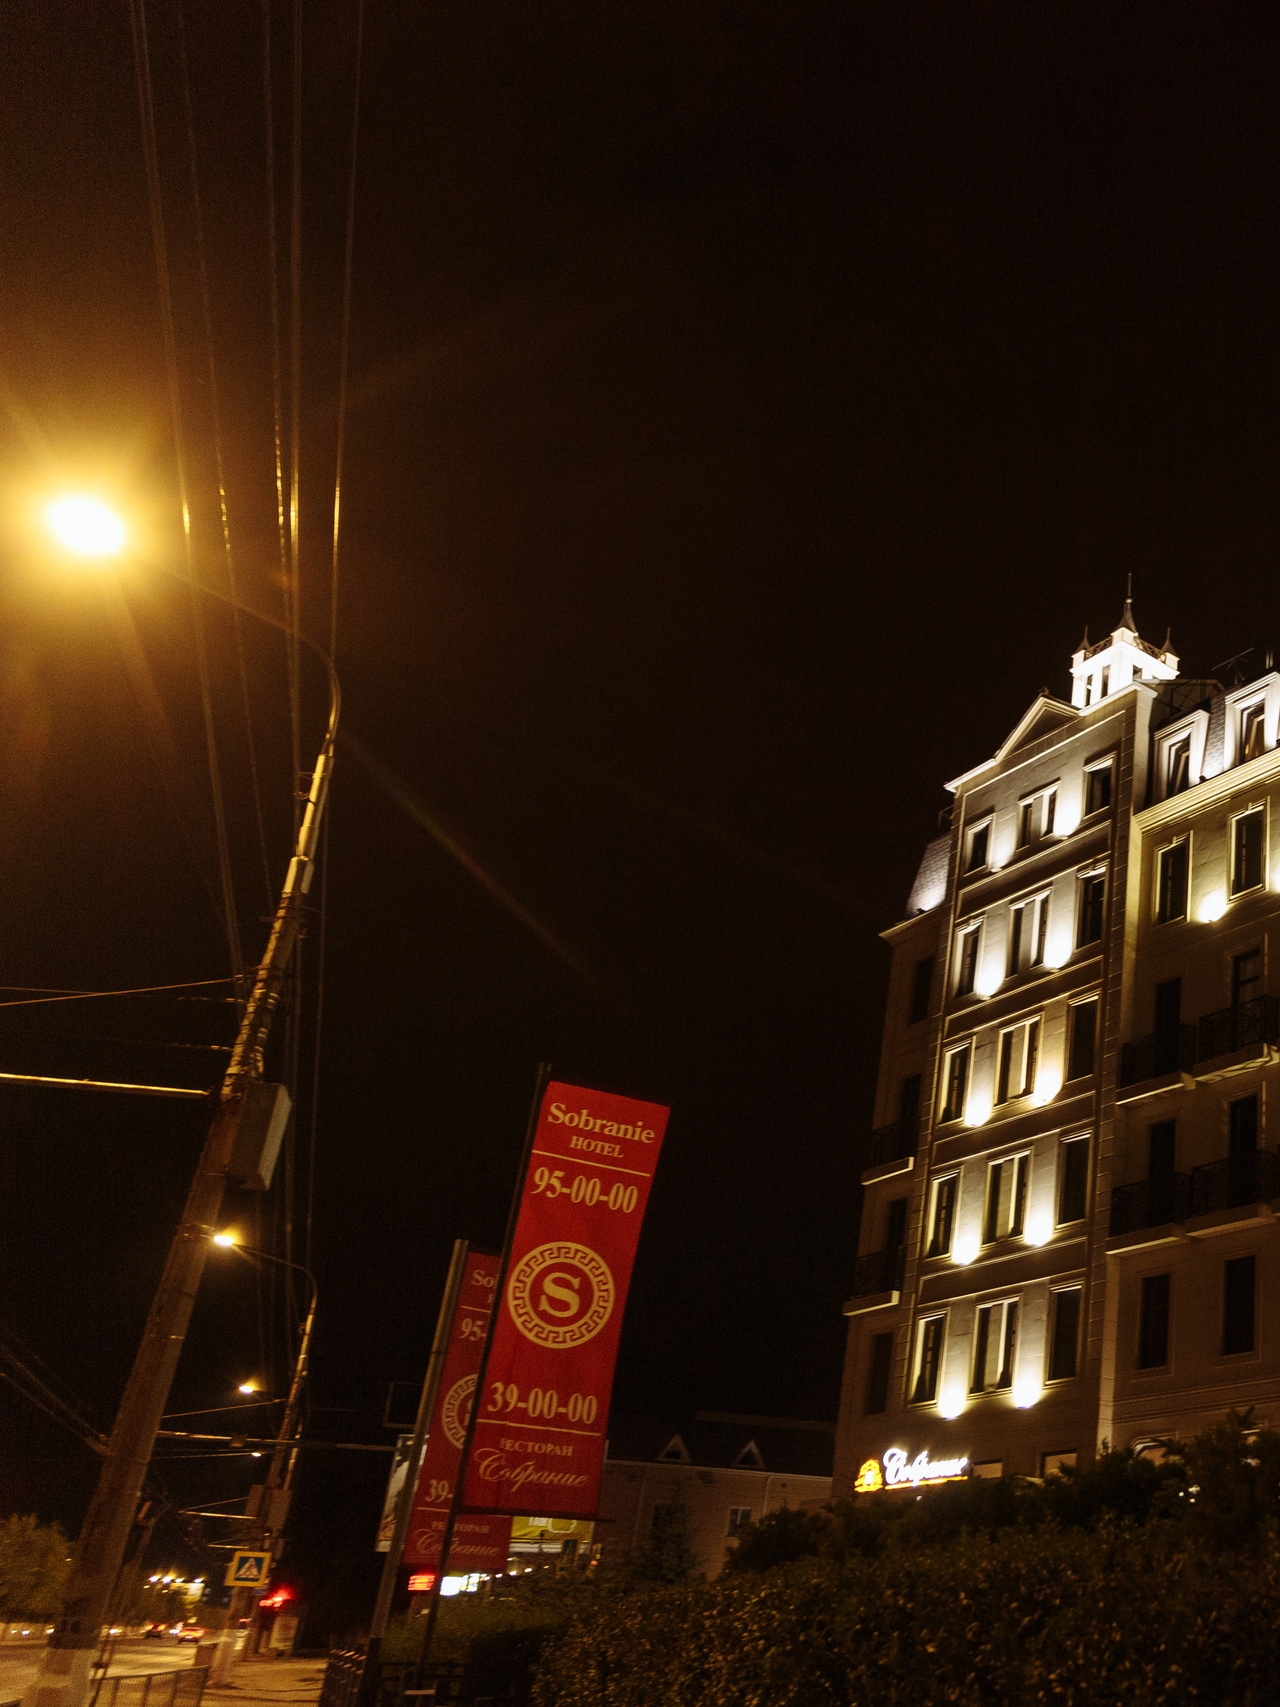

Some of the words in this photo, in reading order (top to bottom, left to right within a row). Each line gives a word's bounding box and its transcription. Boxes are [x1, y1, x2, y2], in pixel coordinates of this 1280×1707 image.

[547, 1102, 656, 1144] Sobranie
[569, 1135, 624, 1158] HOTEL
[530, 1166, 639, 1213] 95-00-00
[539, 1271, 582, 1318] S
[486, 1381, 598, 1424] 39-00-00
[474, 1447, 589, 1492] Собрание
